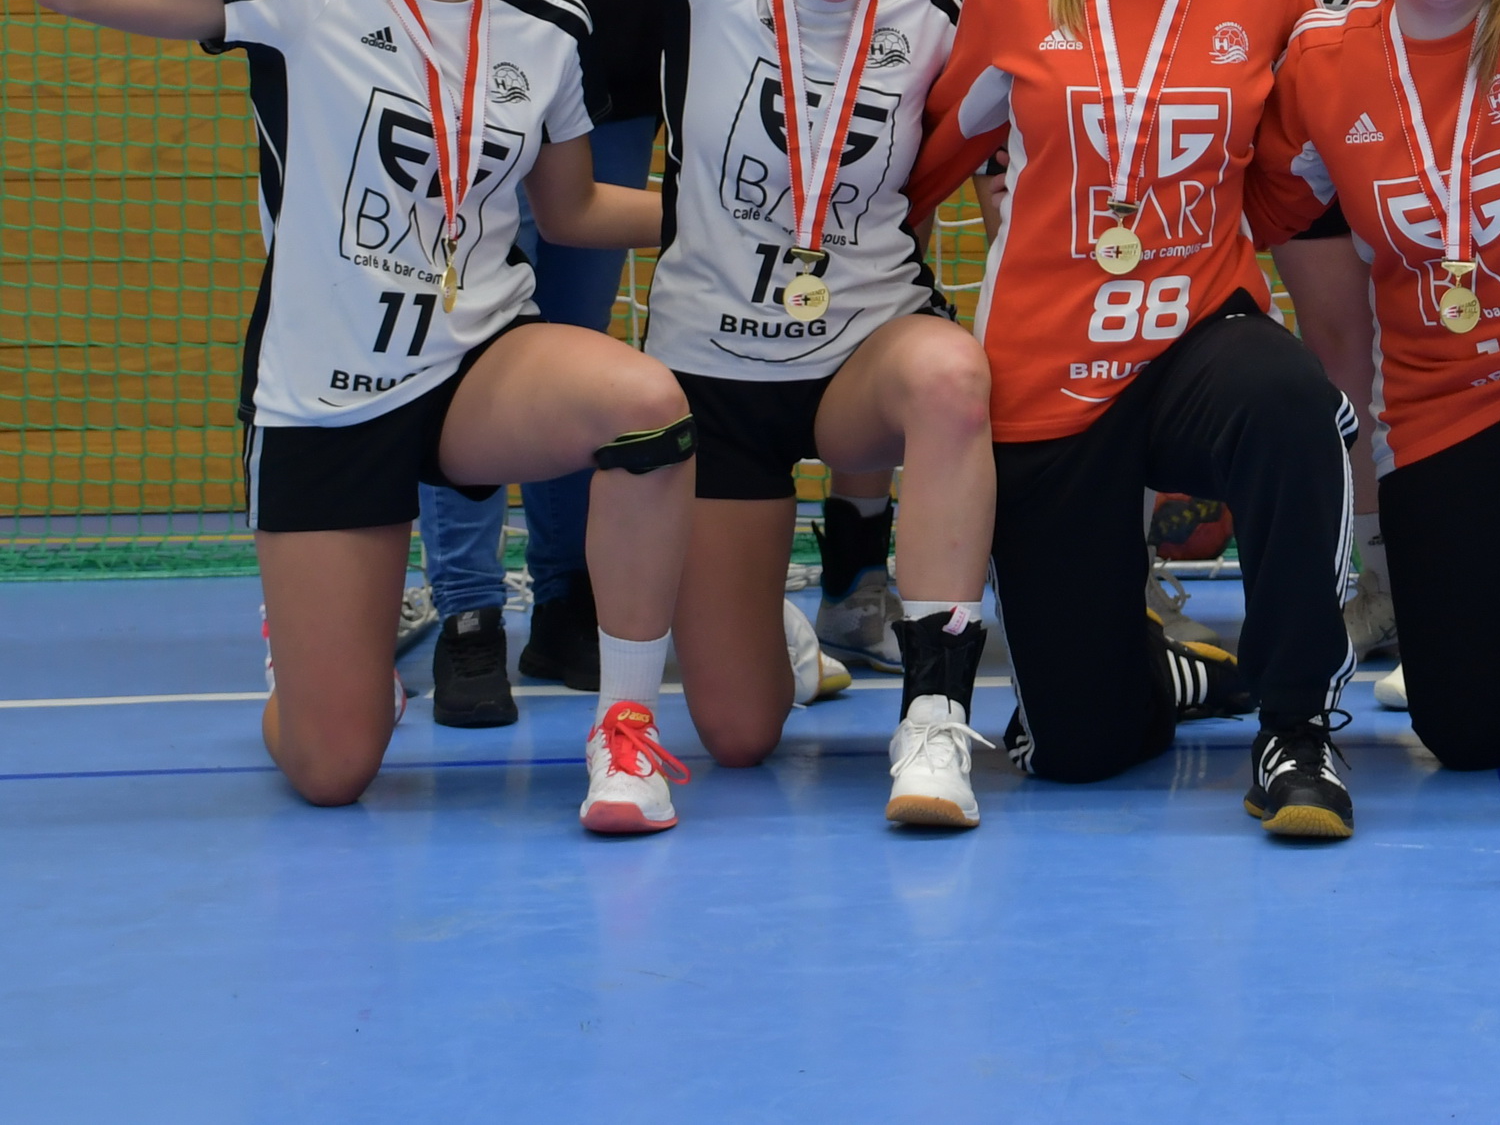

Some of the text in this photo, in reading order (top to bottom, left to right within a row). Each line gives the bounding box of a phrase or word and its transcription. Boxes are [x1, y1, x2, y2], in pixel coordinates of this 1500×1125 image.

[361, 36, 398, 53] adidas
[1039, 41, 1083, 51] adidas
[1345, 132, 1384, 144] adidas
[733, 208, 761, 221] café
[1159, 243, 1202, 259] campus
[354, 254, 379, 269] café
[382, 258, 391, 273] &
[394, 261, 415, 278] bar
[1088, 275, 1192, 342] 88
[373, 291, 437, 356] 11
[720, 313, 827, 338] BRUGG
